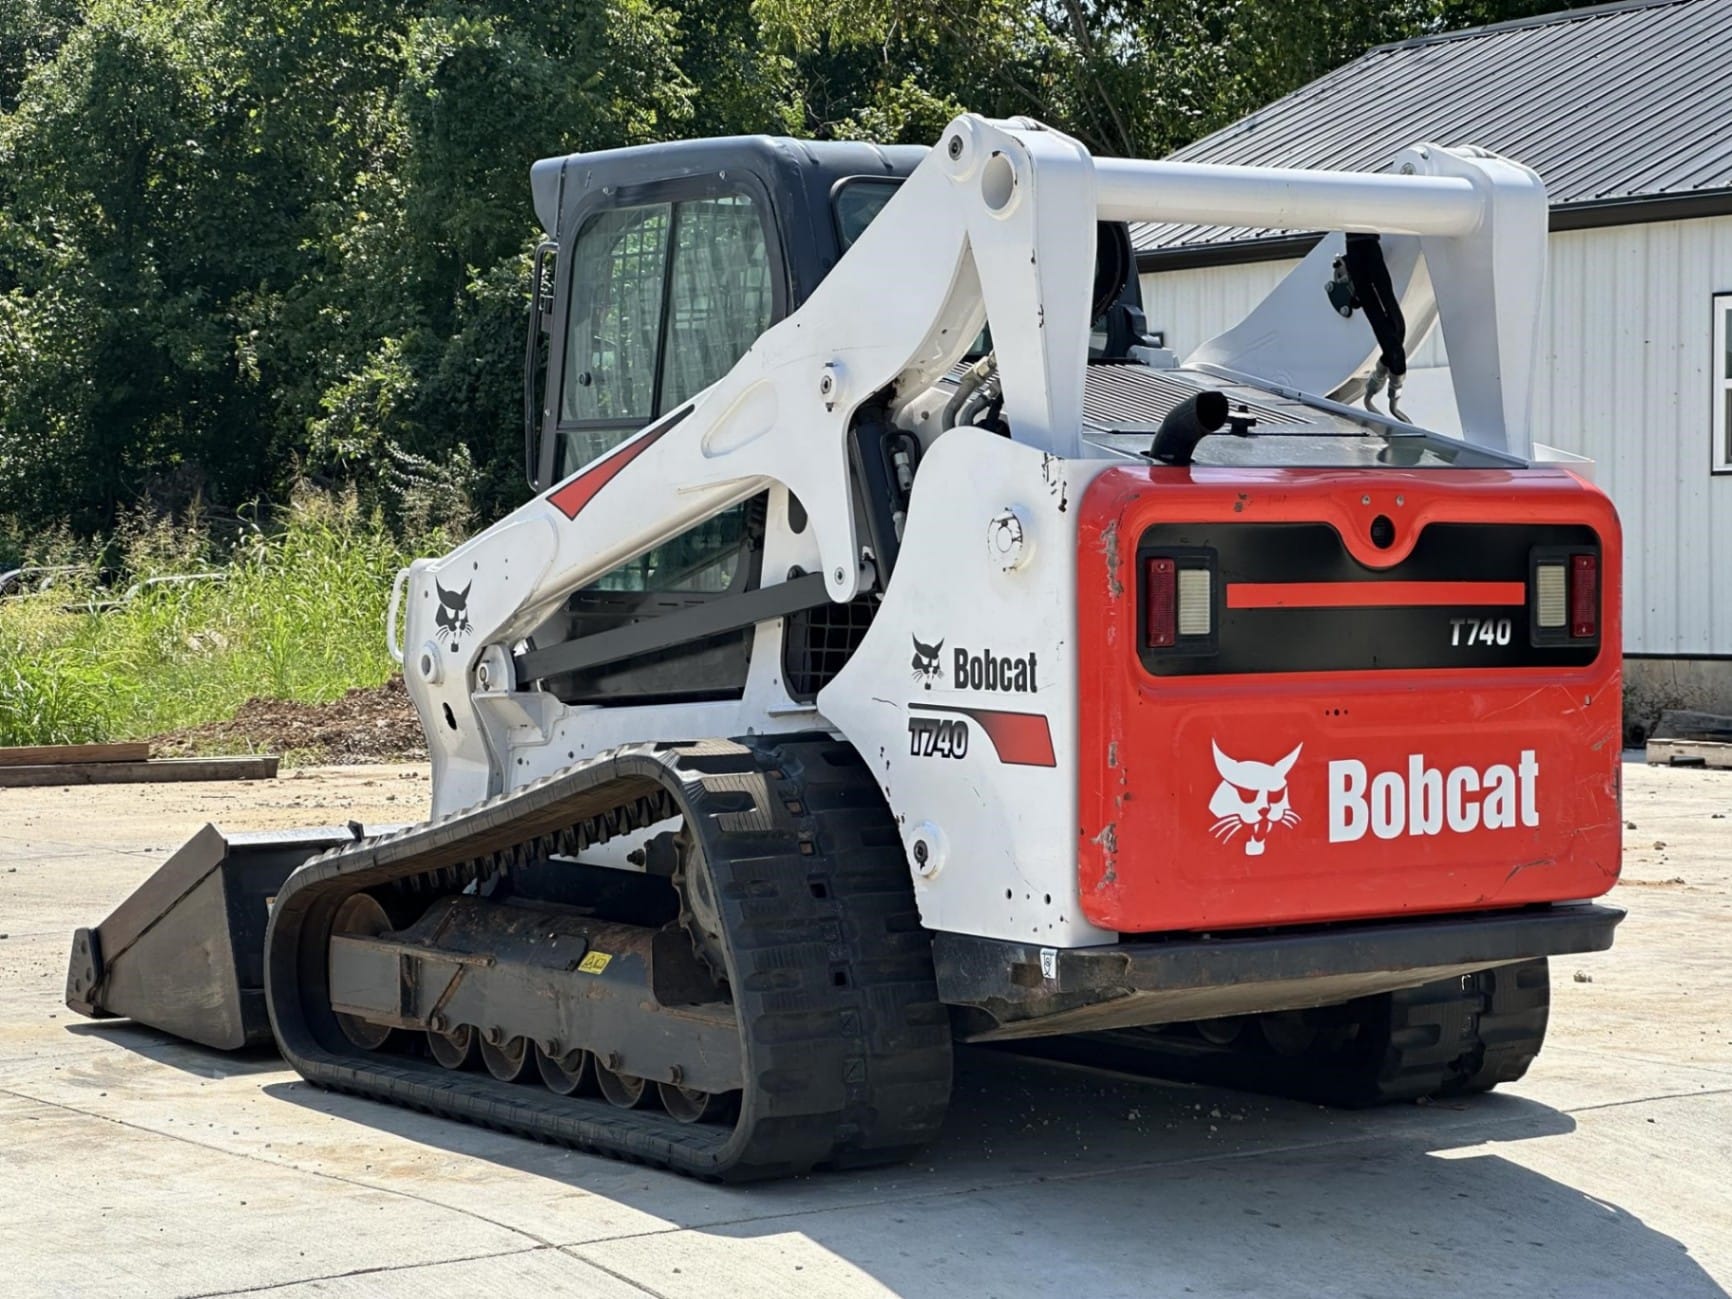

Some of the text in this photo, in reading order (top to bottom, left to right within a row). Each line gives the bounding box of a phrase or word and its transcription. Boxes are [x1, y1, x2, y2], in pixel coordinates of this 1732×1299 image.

[1449, 618, 1512, 646] T740
[953, 647, 1037, 693] Bobcat
[908, 716, 969, 760] T740
[1328, 749, 1539, 843] Bobcat
